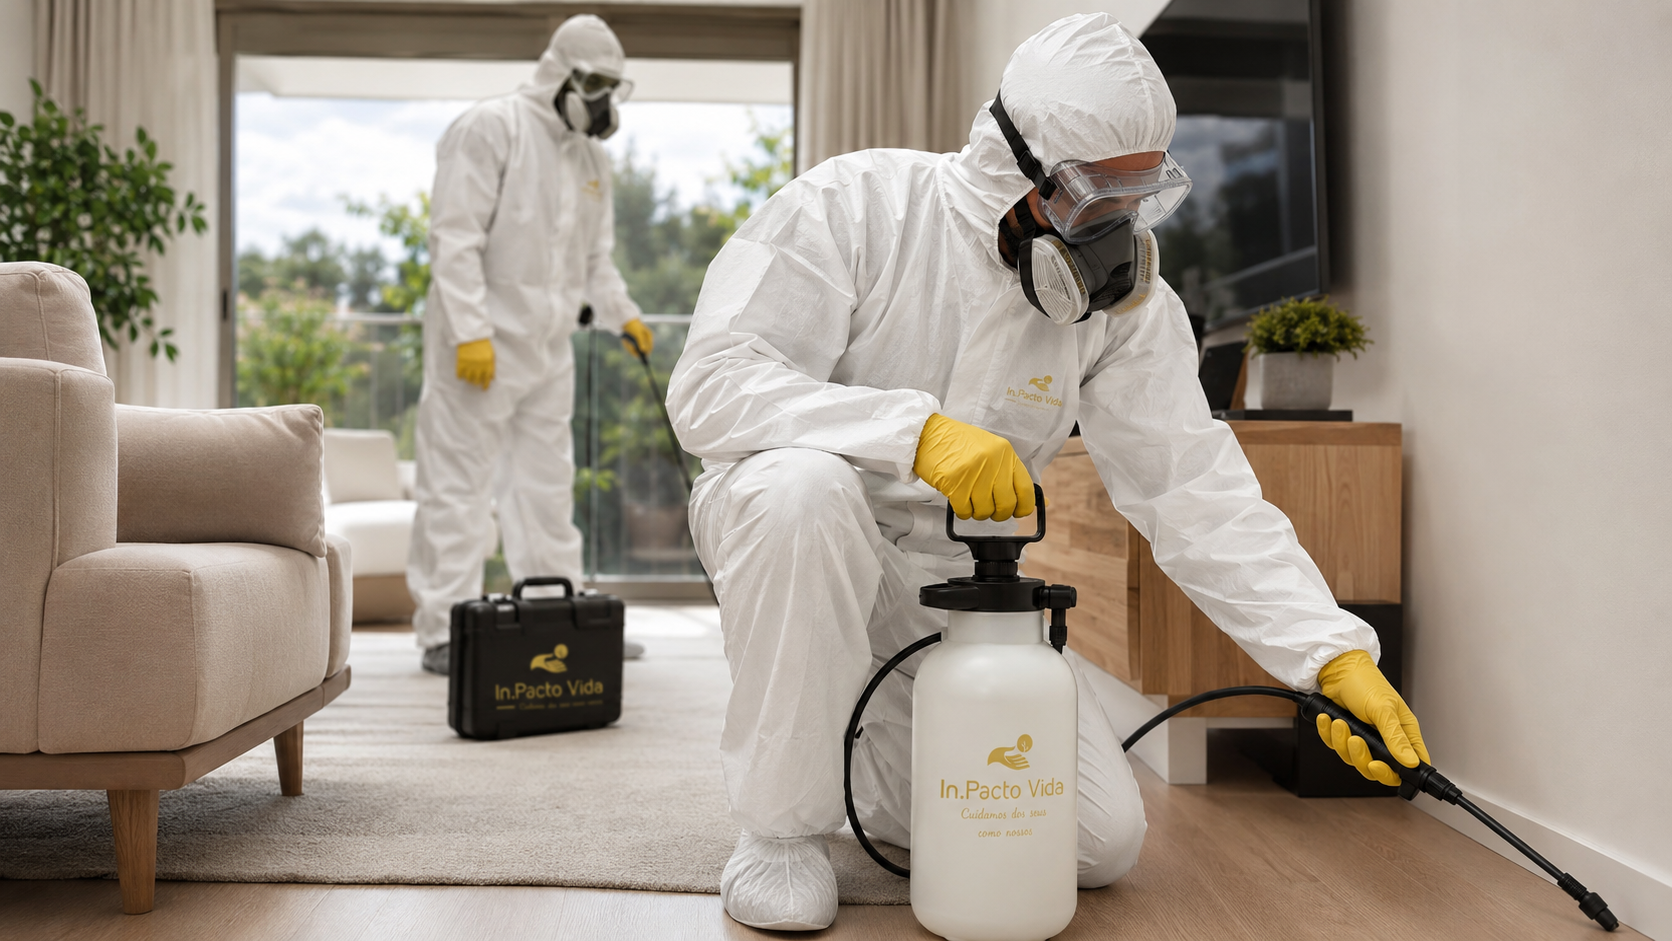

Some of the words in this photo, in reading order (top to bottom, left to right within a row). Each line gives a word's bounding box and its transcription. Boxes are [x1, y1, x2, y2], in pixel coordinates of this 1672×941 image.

[1045, 395, 1063, 408] Vida
[495, 681, 563, 701] In.Pacto
[566, 678, 604, 696] Vida
[940, 779, 1022, 800] In.Pacto
[1027, 777, 1064, 798] Vida
[960, 807, 1007, 820] Cuidamos
[1011, 806, 1026, 819] dos
[1029, 809, 1047, 818] seus
[977, 829, 1002, 838] como
[1005, 828, 1033, 837] nossos
